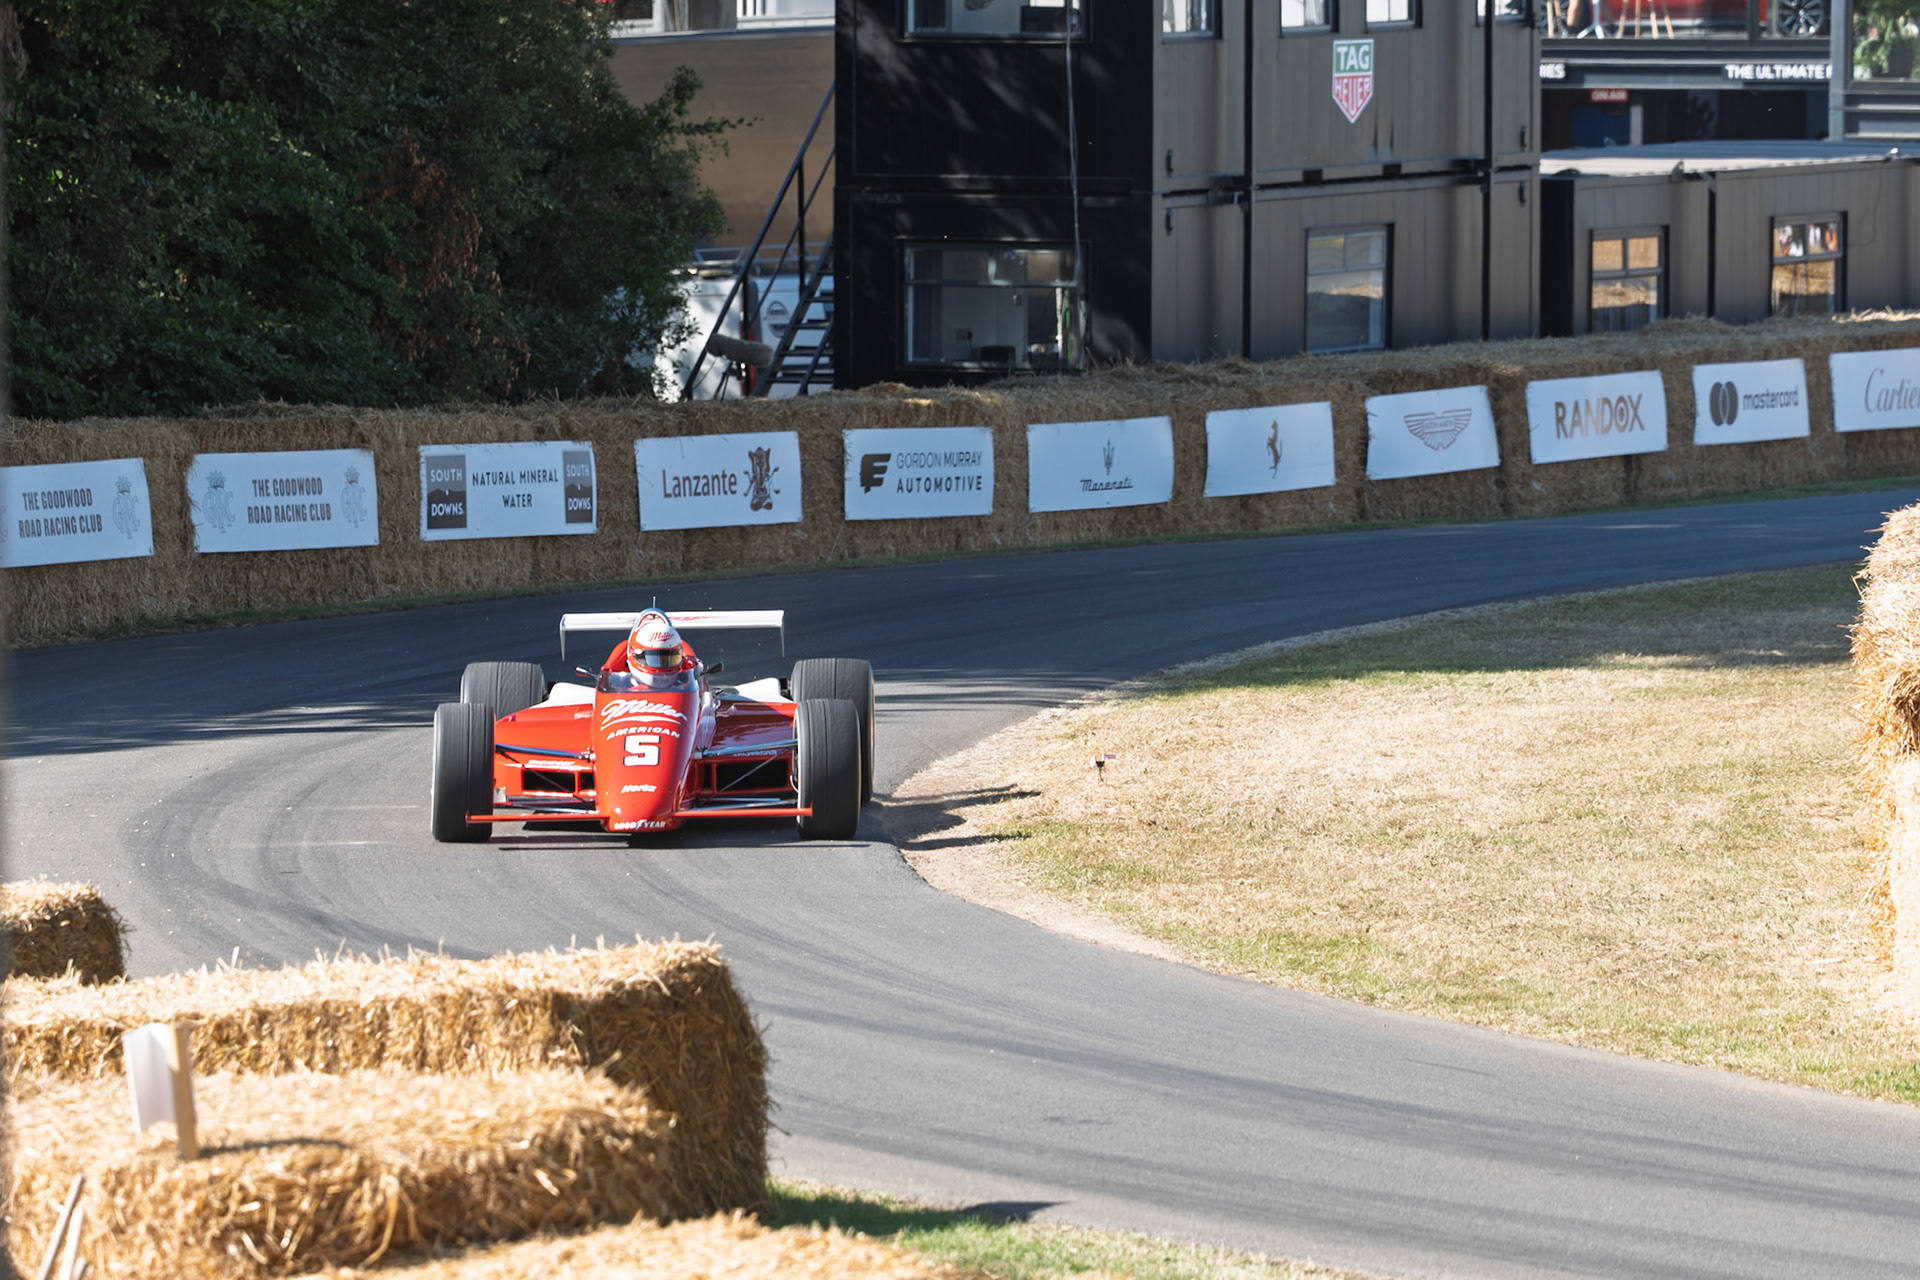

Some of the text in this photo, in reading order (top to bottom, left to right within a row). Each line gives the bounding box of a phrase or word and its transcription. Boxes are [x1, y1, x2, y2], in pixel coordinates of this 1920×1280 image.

[1337, 45, 1370, 71] TAG
[1725, 64, 1755, 79] THE
[1755, 64, 1825, 79] ULTIMATE
[1335, 78, 1371, 115] HEUER
[1742, 385, 1799, 410] mastercard
[1555, 393, 1645, 440] RANDOX
[896, 451, 983, 469] GORDON MURRAY
[430, 469, 463, 483] SOUTH
[472, 469, 559, 487] NATURAL MINERAL
[565, 464, 590, 478] SOUTH
[252, 477, 323, 498] THE GOODWOOD
[662, 469, 738, 499] Lanzante
[896, 475, 983, 494] AUTOMOTIVE
[1080, 476, 1133, 492] Maserati
[22, 488, 93, 511] THE GOODWOOD
[502, 494, 533, 509] WATER
[568, 497, 591, 512] DOWNS
[247, 503, 332, 524] ROAD RACING CLUB
[431, 503, 463, 517] DOWNS
[18, 514, 103, 539] ROAD RACING CLUB
[601, 699, 688, 725] Miller
[606, 726, 680, 741] AMERICAN
[623, 734, 660, 767] 5
